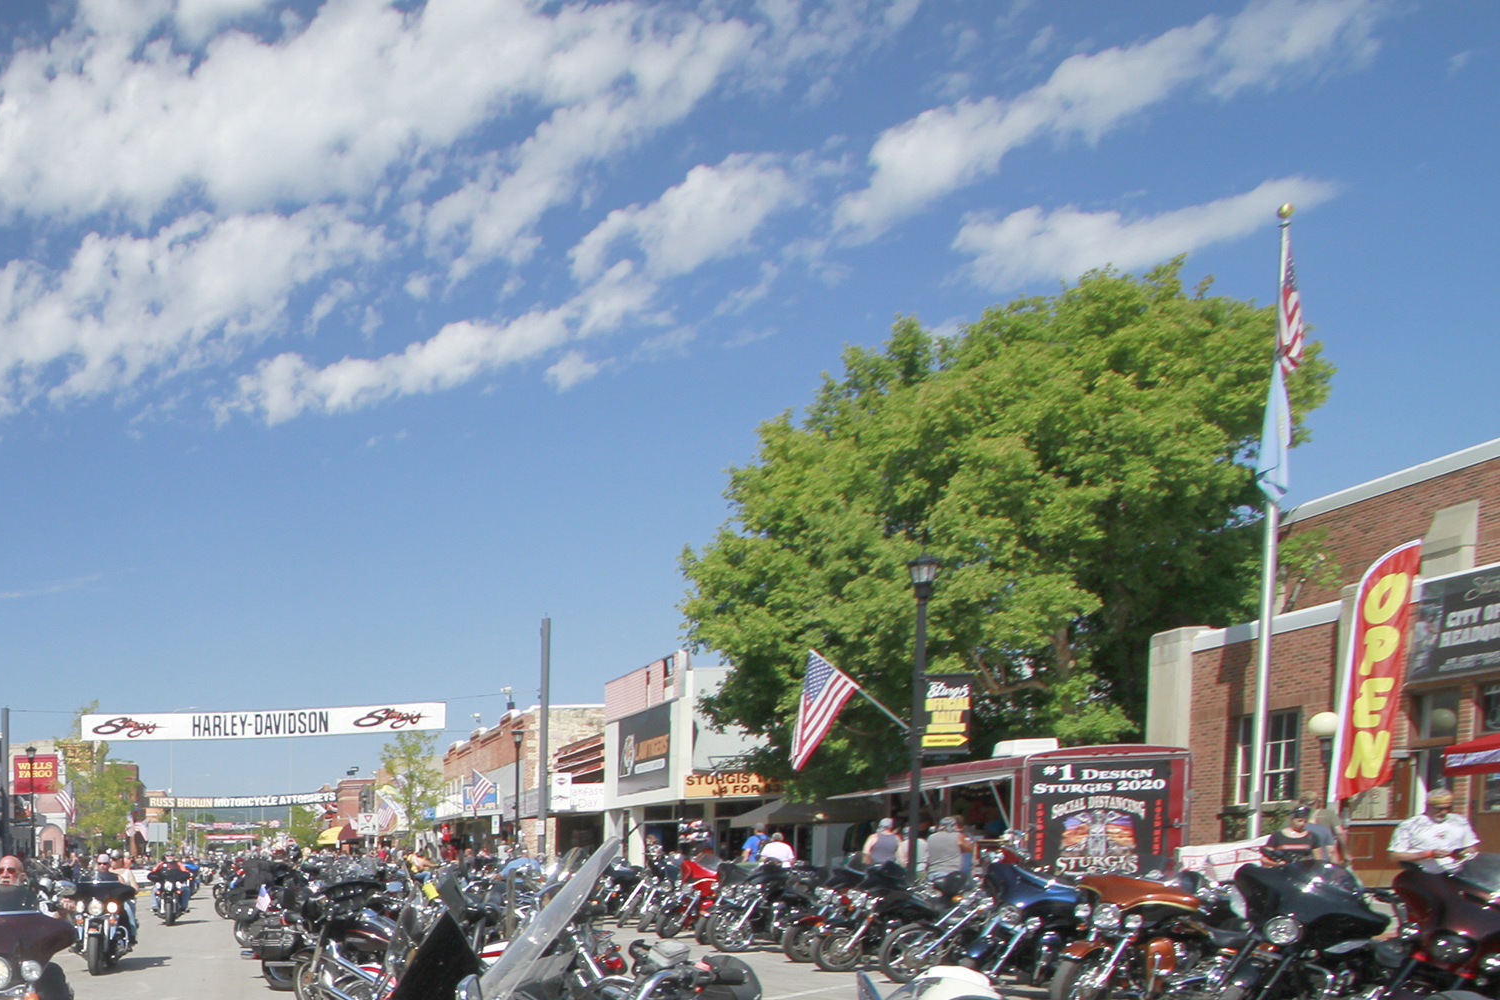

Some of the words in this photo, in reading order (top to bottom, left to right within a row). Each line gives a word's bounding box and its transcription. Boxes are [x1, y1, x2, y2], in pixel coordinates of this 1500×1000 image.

[1445, 606, 1482, 628] CITY
[1345, 572, 1408, 778] OPEN
[927, 682, 970, 699] Sturgis
[192, 711, 329, 737] HARLEY-DAVIDSON
[17, 761, 53, 770] WELLS
[1043, 764, 1075, 781] #1
[18, 770, 53, 778] FARGO
[686, 773, 750, 786] STURGIS
[733, 784, 761, 794] FOR
[1033, 782, 1113, 794] STURGIS
[1116, 779, 1166, 791] 2020
[149, 797, 175, 807] RUSS
[177, 797, 213, 808] BROWN
[214, 795, 277, 807] MOTORCYCLE
[279, 792, 336, 805] ATTORNEYS
[1051, 797, 1086, 820] SOCIAL
[1087, 795, 1147, 820] DISTANCING
